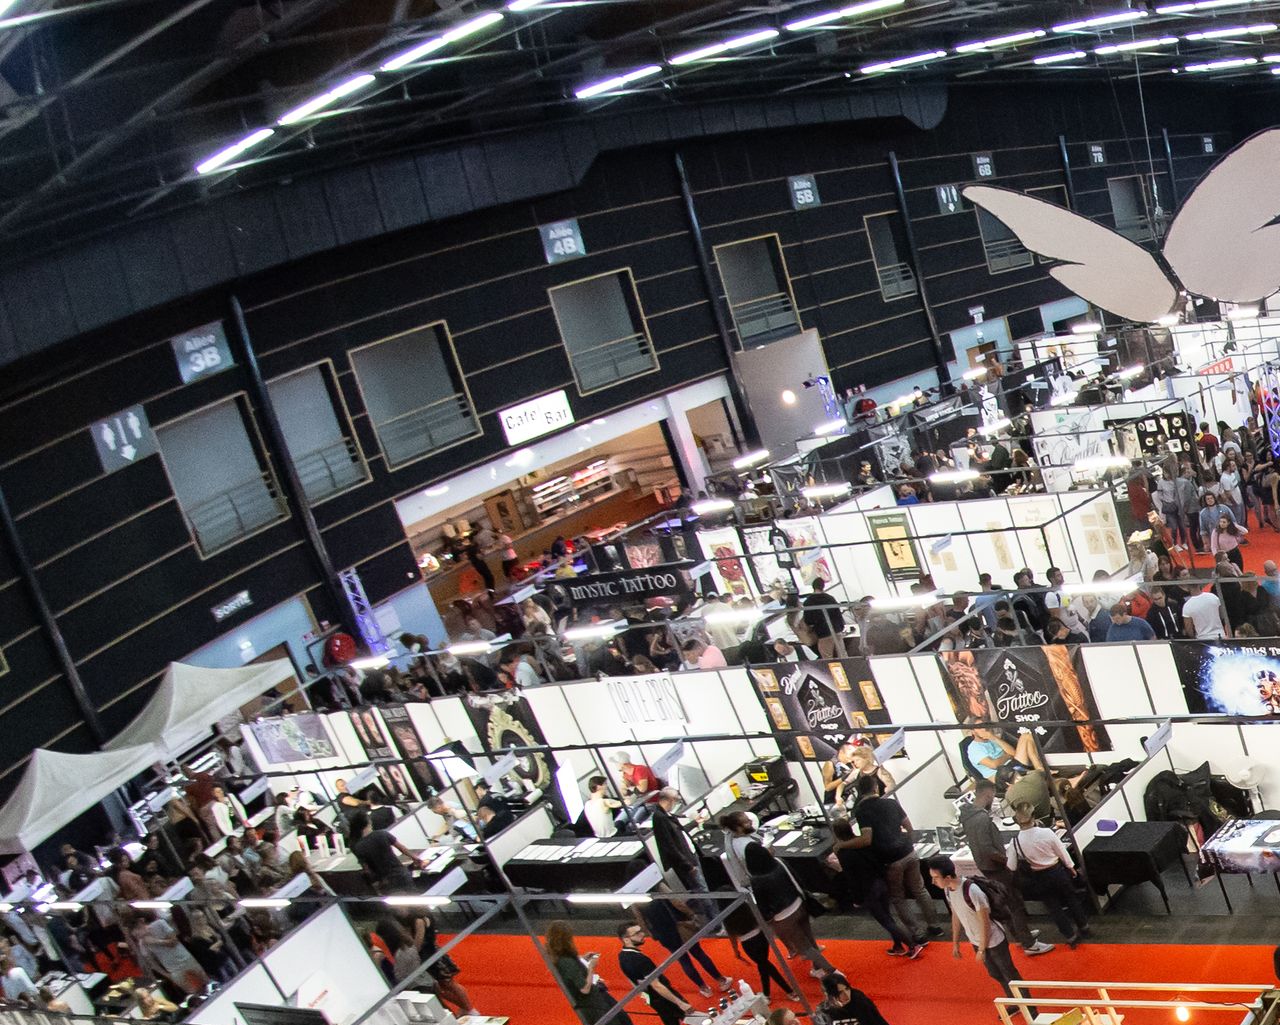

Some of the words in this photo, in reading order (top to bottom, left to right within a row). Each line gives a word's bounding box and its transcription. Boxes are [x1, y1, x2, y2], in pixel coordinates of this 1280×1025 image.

[796, 189, 815, 205] 5B
[552, 237, 577, 256] 4B
[189, 346, 222, 373] 3B
[544, 408, 567, 425] Bar
[619, 573, 677, 593] TATTOO
[996, 682, 1049, 720] Tattoo
[1015, 713, 1041, 723] SHOP
